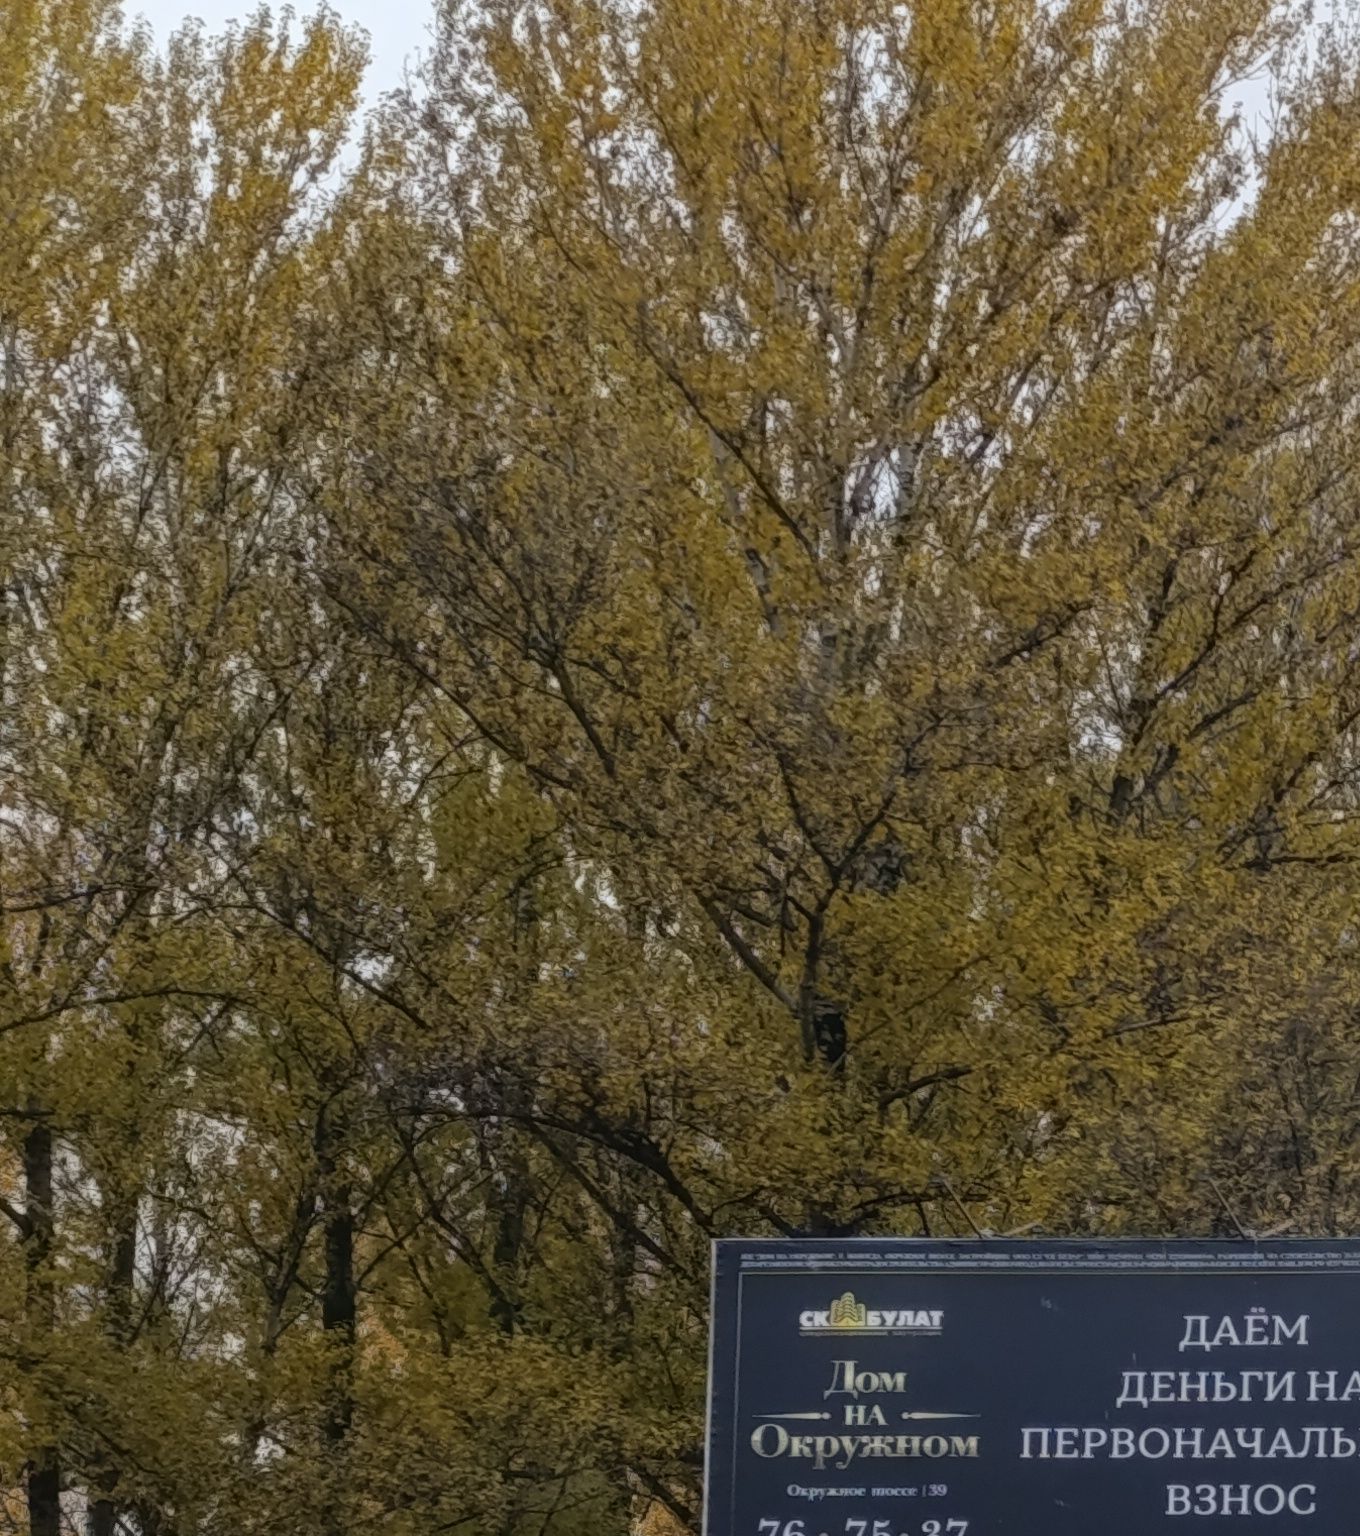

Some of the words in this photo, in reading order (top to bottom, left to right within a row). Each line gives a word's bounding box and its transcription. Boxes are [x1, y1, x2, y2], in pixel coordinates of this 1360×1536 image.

[867, 1310, 944, 1327] БУЛАТ
[1178, 1306, 1310, 1352] ДАЁМ
[823, 1360, 907, 1400] Дом
[1116, 1371, 1296, 1408] ДЕНЬГИ
[750, 1423, 981, 1470] Окружном
[1165, 1484, 1317, 1515] ВЗНОС
